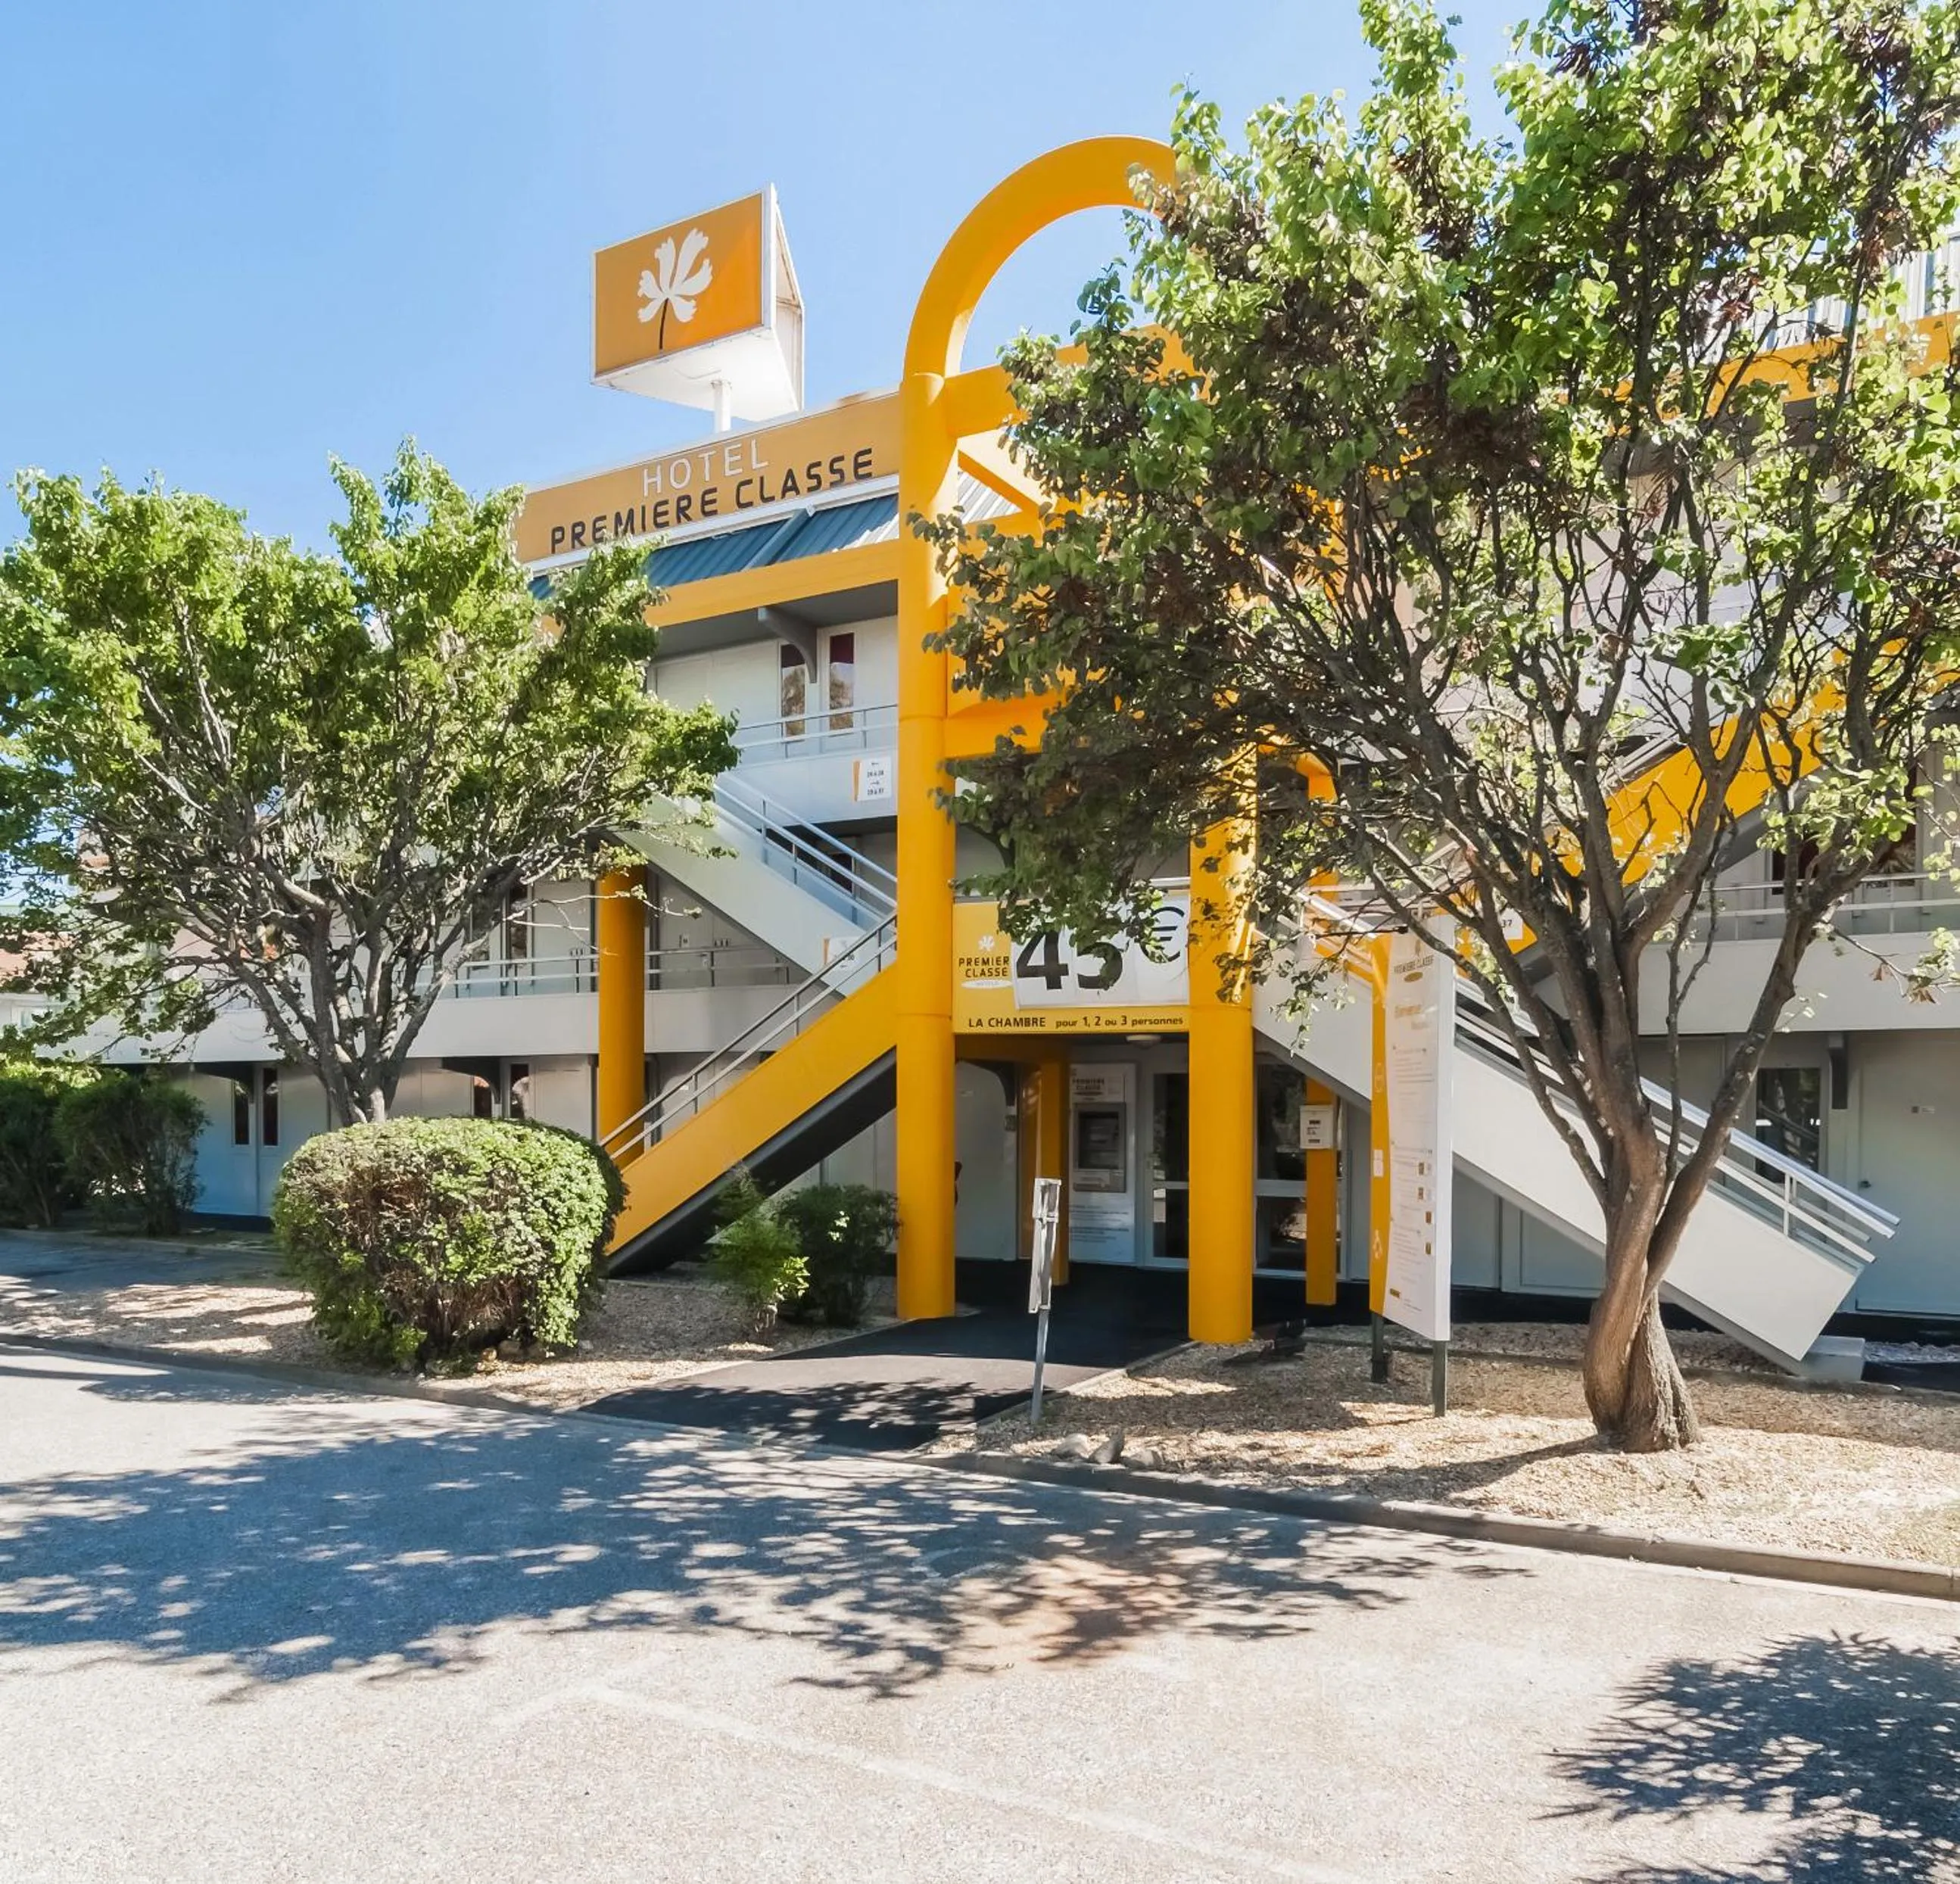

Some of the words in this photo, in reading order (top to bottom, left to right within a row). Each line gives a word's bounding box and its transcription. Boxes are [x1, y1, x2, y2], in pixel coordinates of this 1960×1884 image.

[643, 439, 768, 497] HOTEL
[551, 487, 718, 554] PREMIERE
[735, 448, 874, 509] CLASSE
[958, 956, 1010, 967] PREMIER
[965, 967, 1008, 978] CLASSE
[969, 1017, 983, 1028] LA
[988, 1017, 1046, 1028] CHAMBRE
[1055, 1019, 1078, 1029] pour
[1095, 1016, 1101, 1026] 2
[1105, 1018, 1117, 1026] ou
[1120, 1015, 1127, 1026] 3
[1131, 1017, 1183, 1027] personnes
